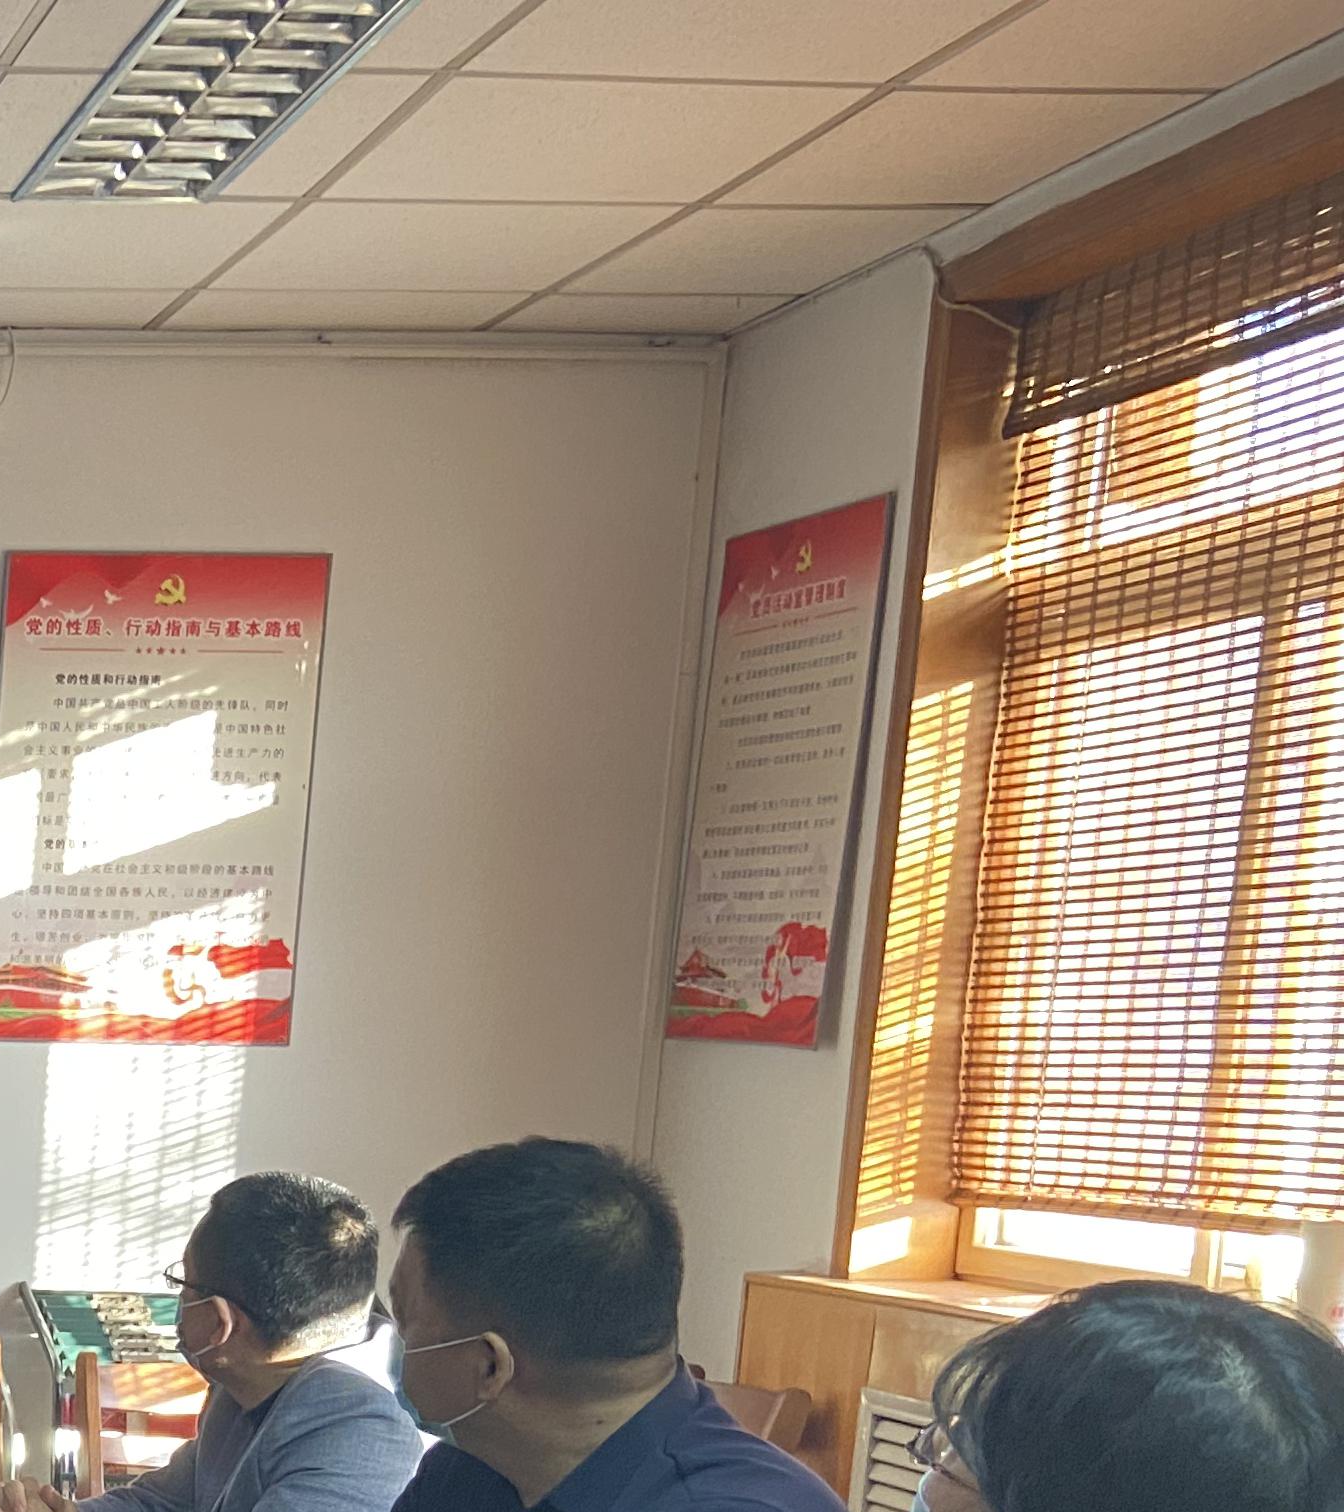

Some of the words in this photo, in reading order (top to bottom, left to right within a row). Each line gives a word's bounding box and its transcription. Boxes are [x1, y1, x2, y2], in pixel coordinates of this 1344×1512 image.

[24, 616, 304, 639] 党的性质、行动指南与基本路线
[54, 672, 162, 687] 党的性质和行动指南
